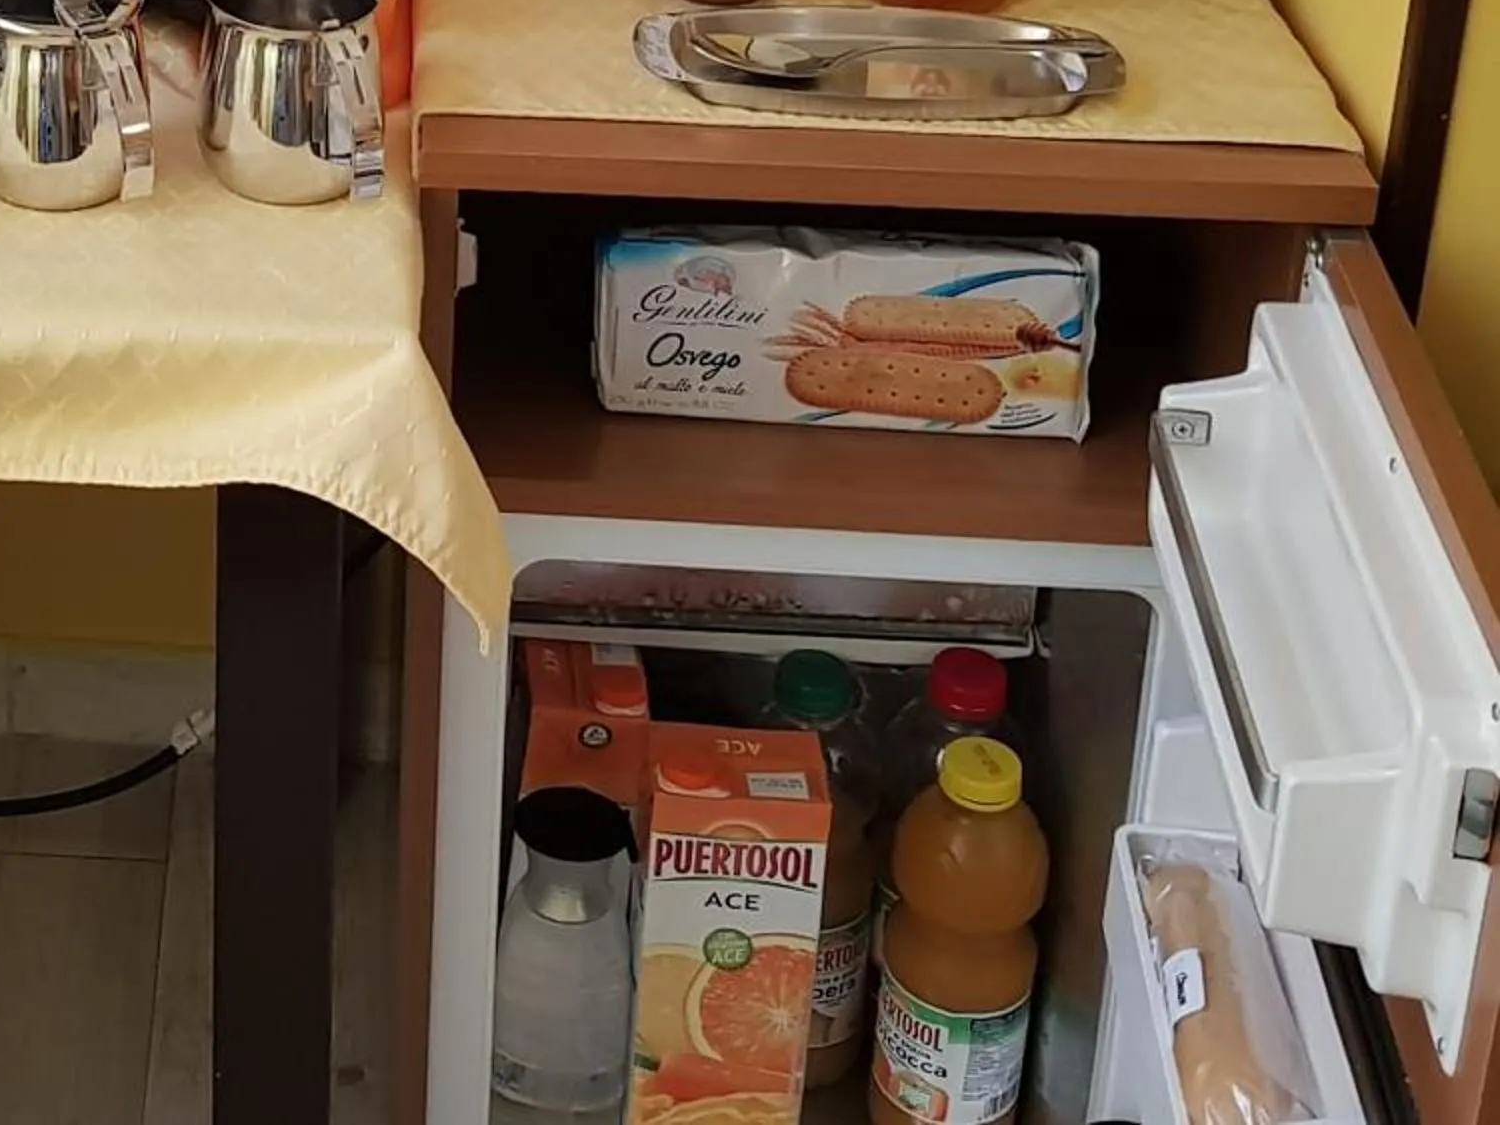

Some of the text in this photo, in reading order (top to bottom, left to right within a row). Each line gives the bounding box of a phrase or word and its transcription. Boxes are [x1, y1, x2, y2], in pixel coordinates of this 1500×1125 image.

[632, 284, 770, 324] Gentilini
[646, 332, 742, 381] Osvego
[654, 838, 819, 889] PUERTOSOL
[704, 891, 761, 912] ACE
